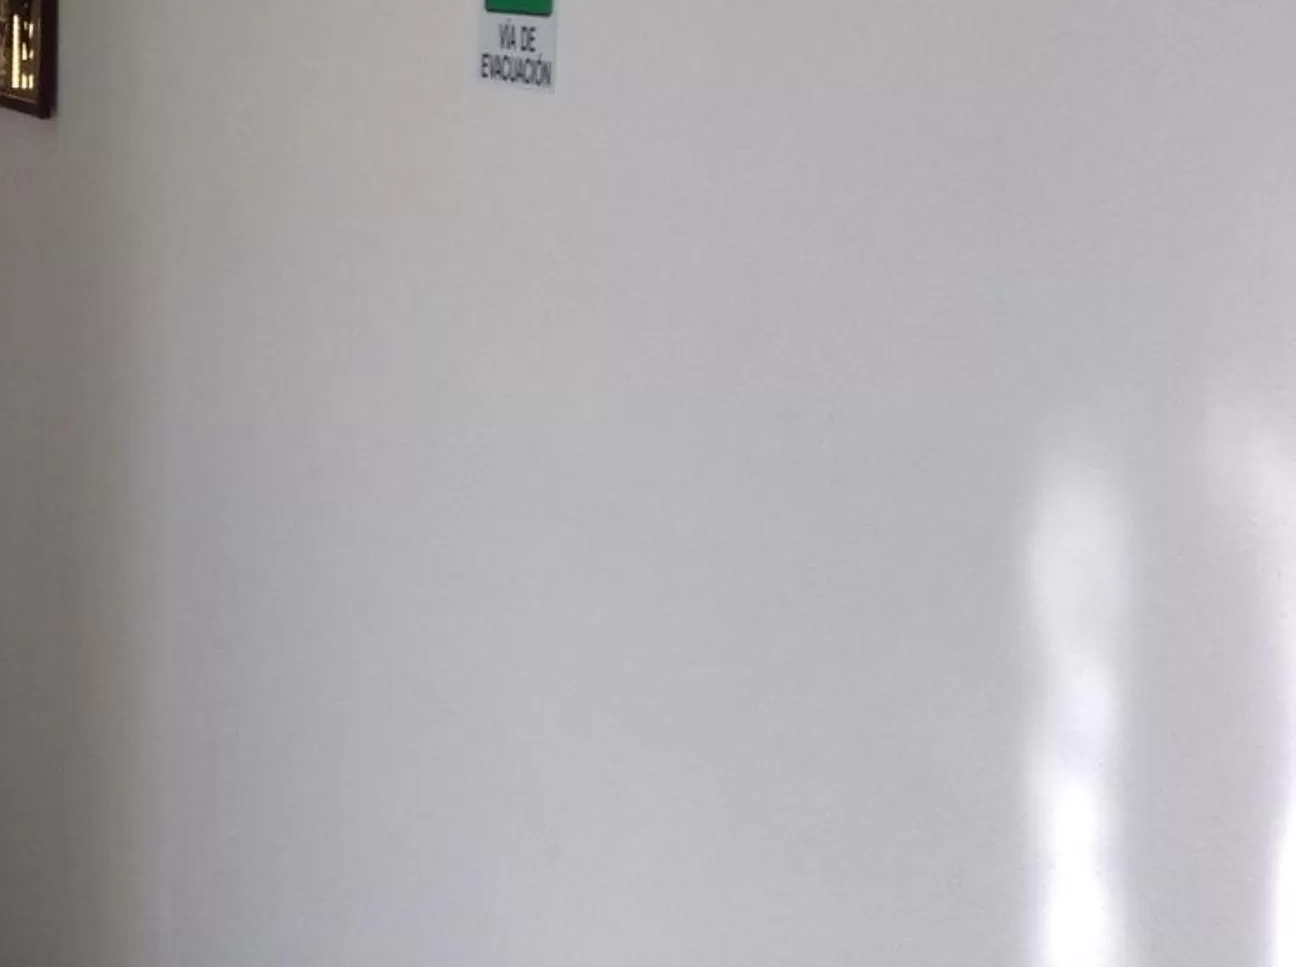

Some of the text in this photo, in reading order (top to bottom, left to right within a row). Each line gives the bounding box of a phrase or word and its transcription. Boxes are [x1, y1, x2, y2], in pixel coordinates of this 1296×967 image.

[499, 18, 536, 51] VÍA DE
[481, 52, 552, 86] EVACUACIÓN
